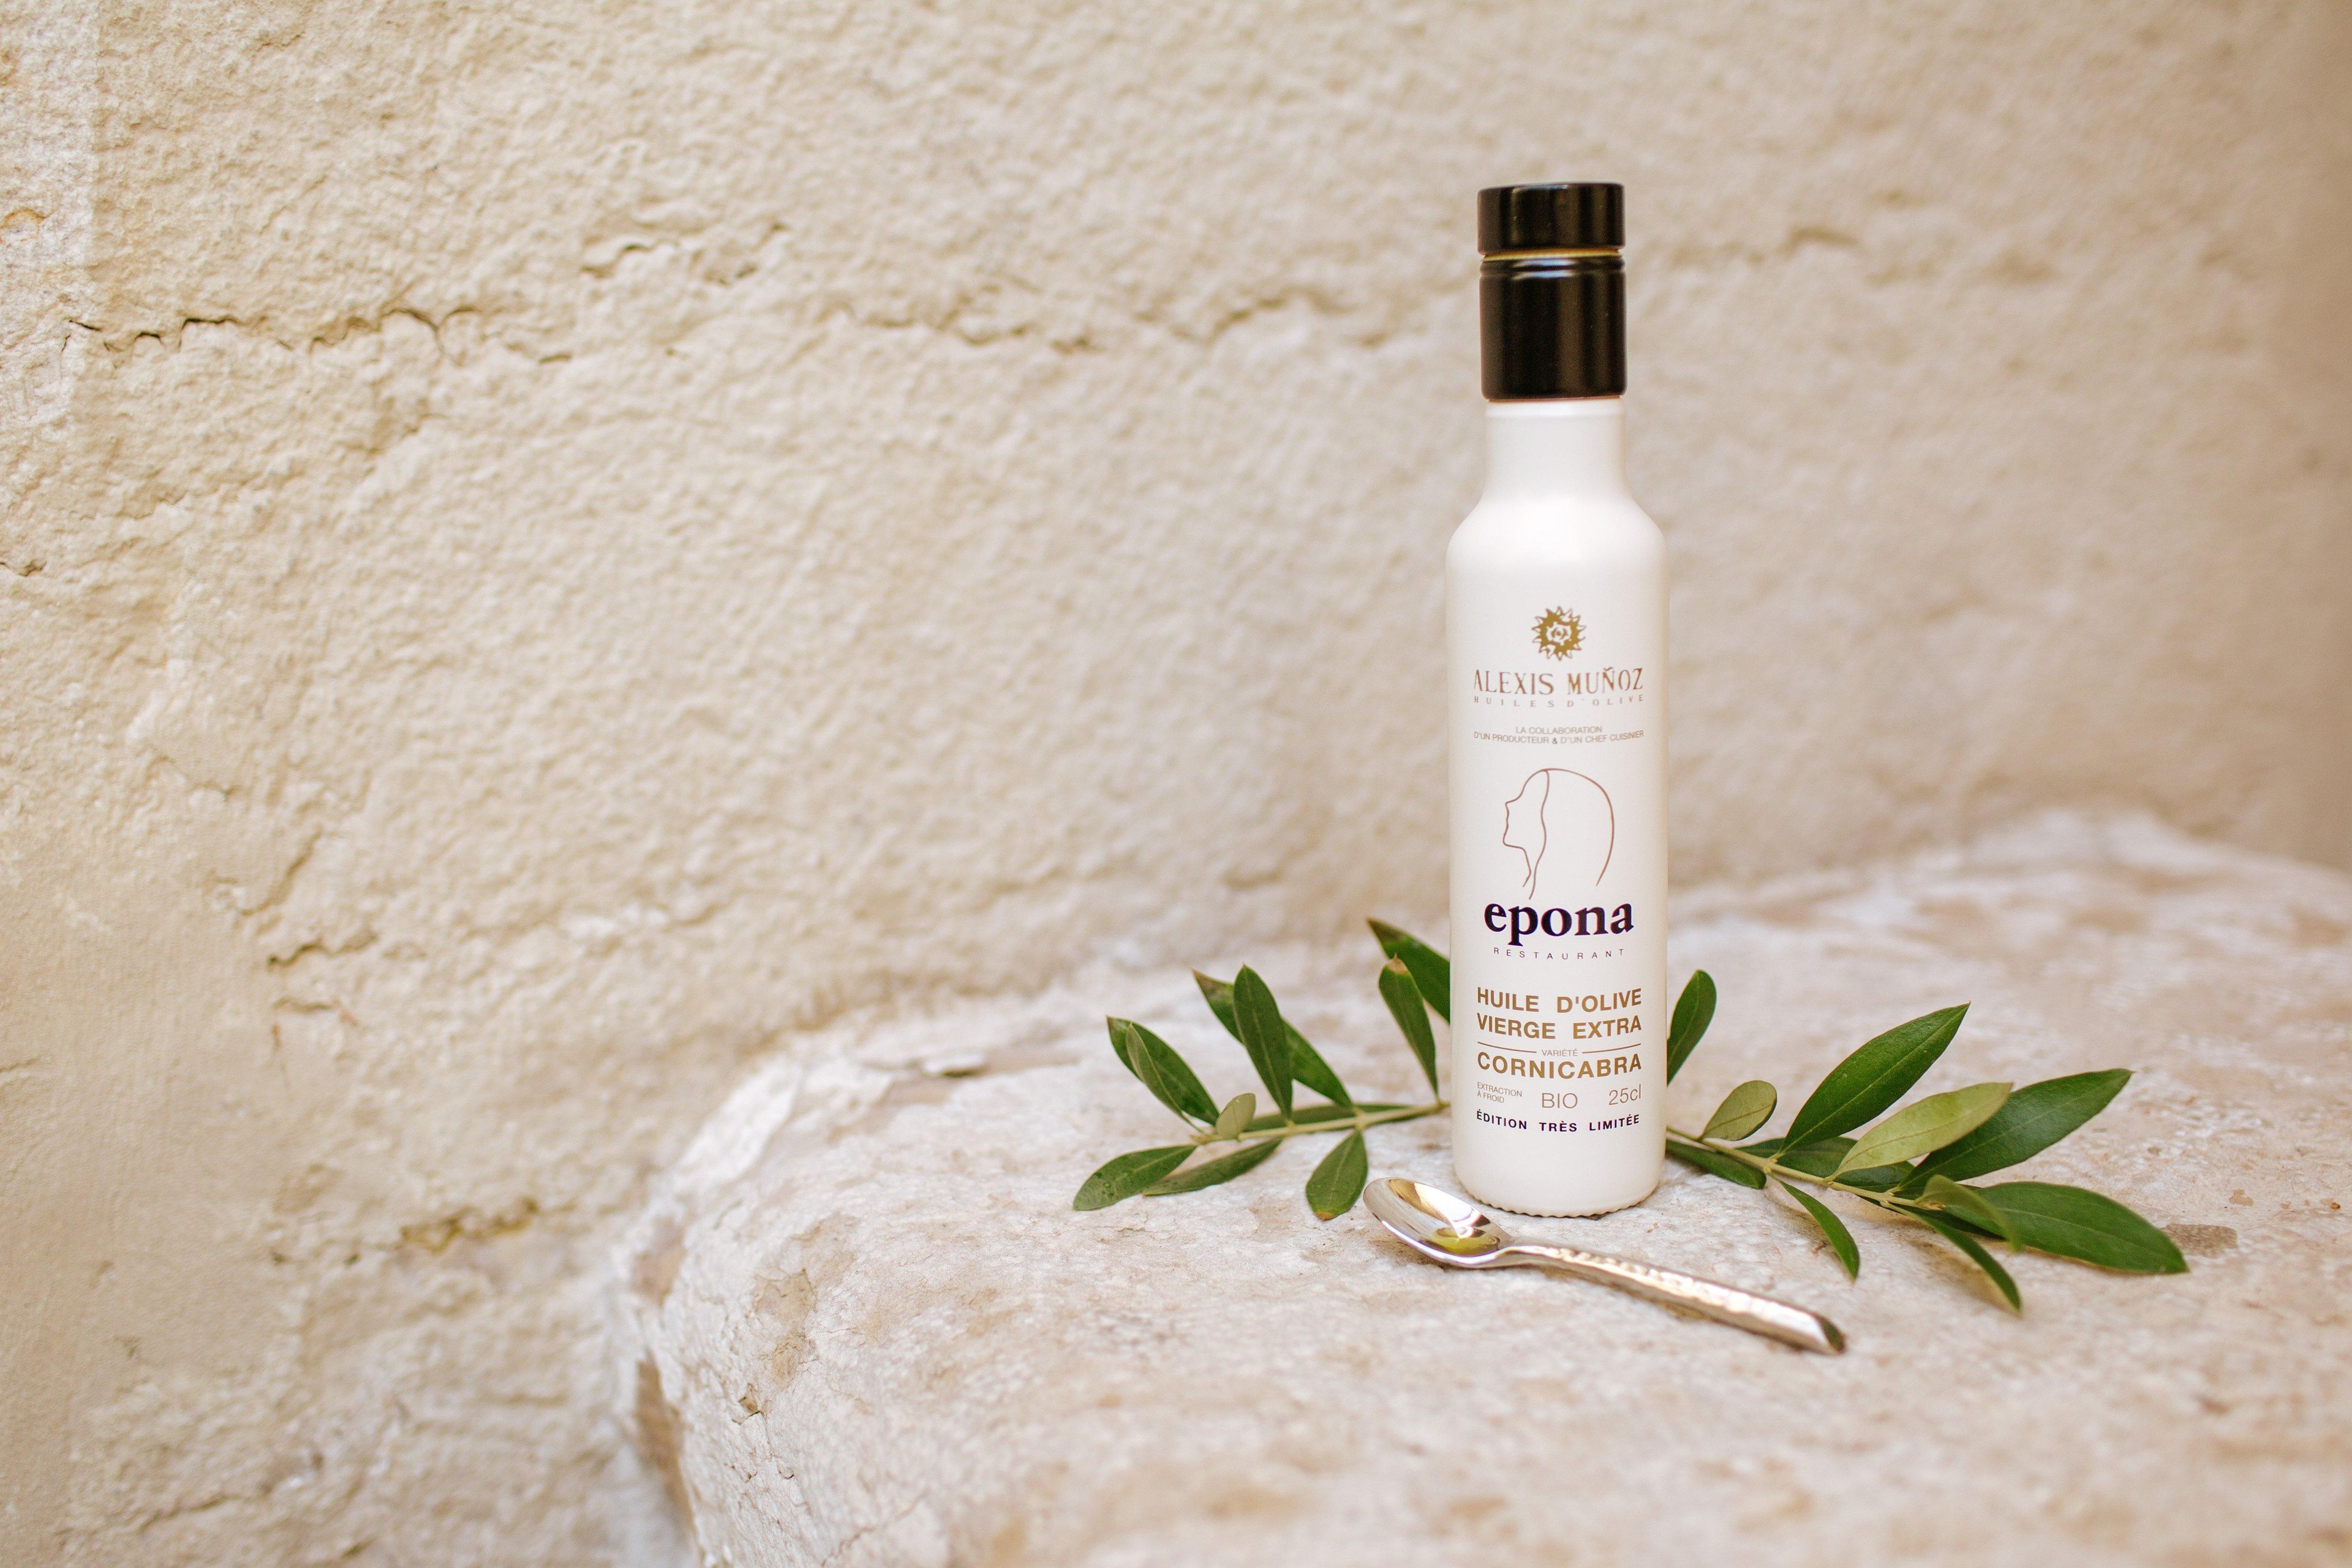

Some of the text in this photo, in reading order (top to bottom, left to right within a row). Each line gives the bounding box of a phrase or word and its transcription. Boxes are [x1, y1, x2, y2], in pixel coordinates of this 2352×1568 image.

[1474, 666, 1643, 695] ALEXIS MUÑOZ
[1474, 696, 1555, 707] HUILES
[1474, 731, 1490, 741] D'UN
[1493, 734, 1549, 744] PRODUCTEUR
[1585, 734, 1607, 743] CHEF
[1610, 730, 1644, 741] CUISINIER
[1529, 726, 1602, 734] COLLABORATION
[1484, 903, 1634, 946] epona
[1494, 948, 1624, 960] RESTAURANT
[1477, 987, 1642, 1013] HUILE D'OLIVE
[1477, 1012, 1642, 1039] VIERGE EXTRA
[1542, 1049, 1578, 1057] VARIÉTÉ
[1477, 1052, 1642, 1079] CORNICABRA
[1477, 1082, 1522, 1098] EXTRACTION
[1477, 1088, 1504, 1103] À FROID
[1608, 1084, 1642, 1106] 25cl
[1542, 1093, 1578, 1109] BIO
[1477, 1109, 1640, 1132] ÉDITION TRÈS LIMITÉE
